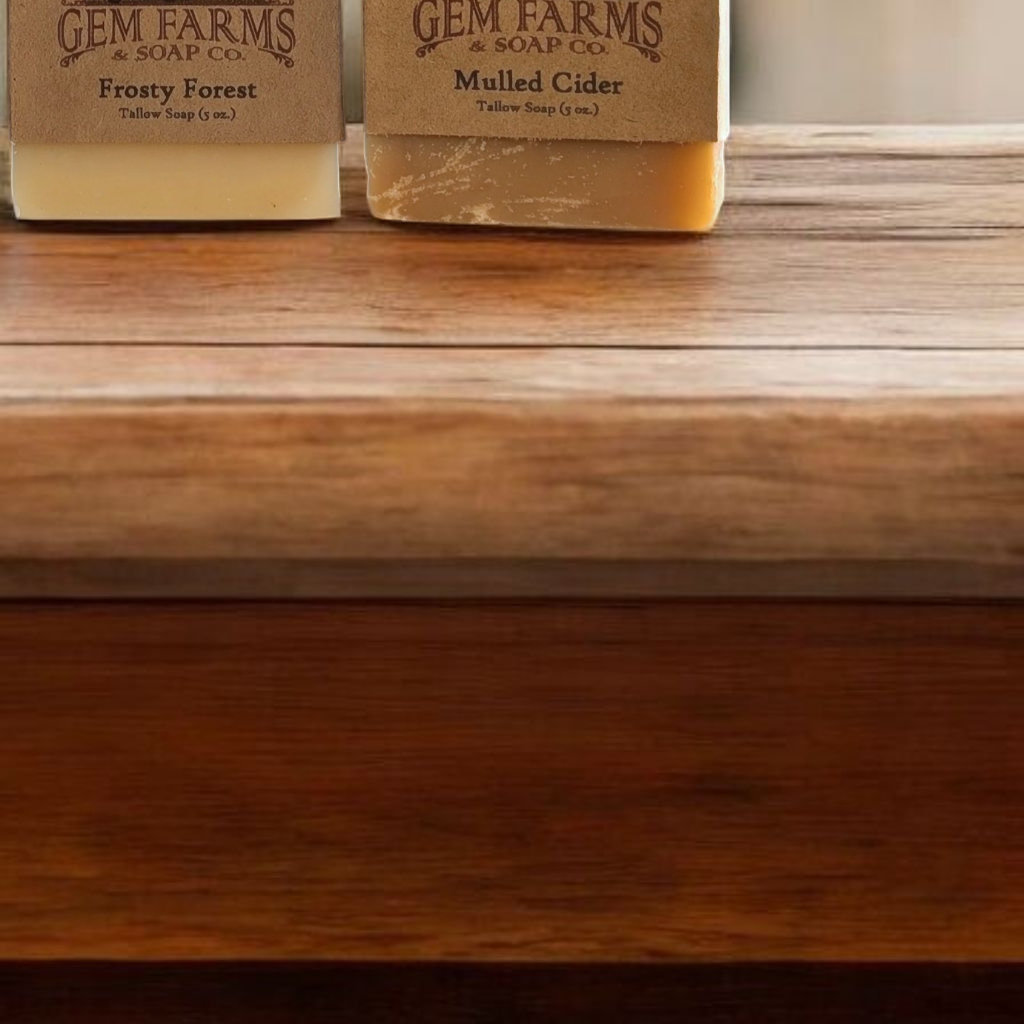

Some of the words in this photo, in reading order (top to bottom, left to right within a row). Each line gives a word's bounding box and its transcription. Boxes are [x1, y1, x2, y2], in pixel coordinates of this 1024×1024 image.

[58, 8, 143, 52] GEM
[157, 8, 296, 54] FARMS
[517, 0, 663, 48] FARMS
[111, 49, 128, 61] &
[135, 45, 200, 62] SOAP
[208, 46, 246, 61] CO.
[469, 41, 486, 52] &
[495, 36, 562, 53] SOAP
[569, 39, 609, 55] CO.
[99, 78, 175, 105] Frosty
[183, 78, 257, 99] Forest
[454, 69, 543, 92] Mulled
[552, 71, 623, 94] Cider
[119, 108, 161, 119] Tallow
[165, 108, 195, 121] Soap
[198, 108, 210, 121] (5
[213, 107, 236, 120] oz.)
[476, 100, 520, 112] Tallow
[524, 102, 556, 115] Soap
[559, 102, 571, 115] (5
[575, 103, 599, 116] oz.)
